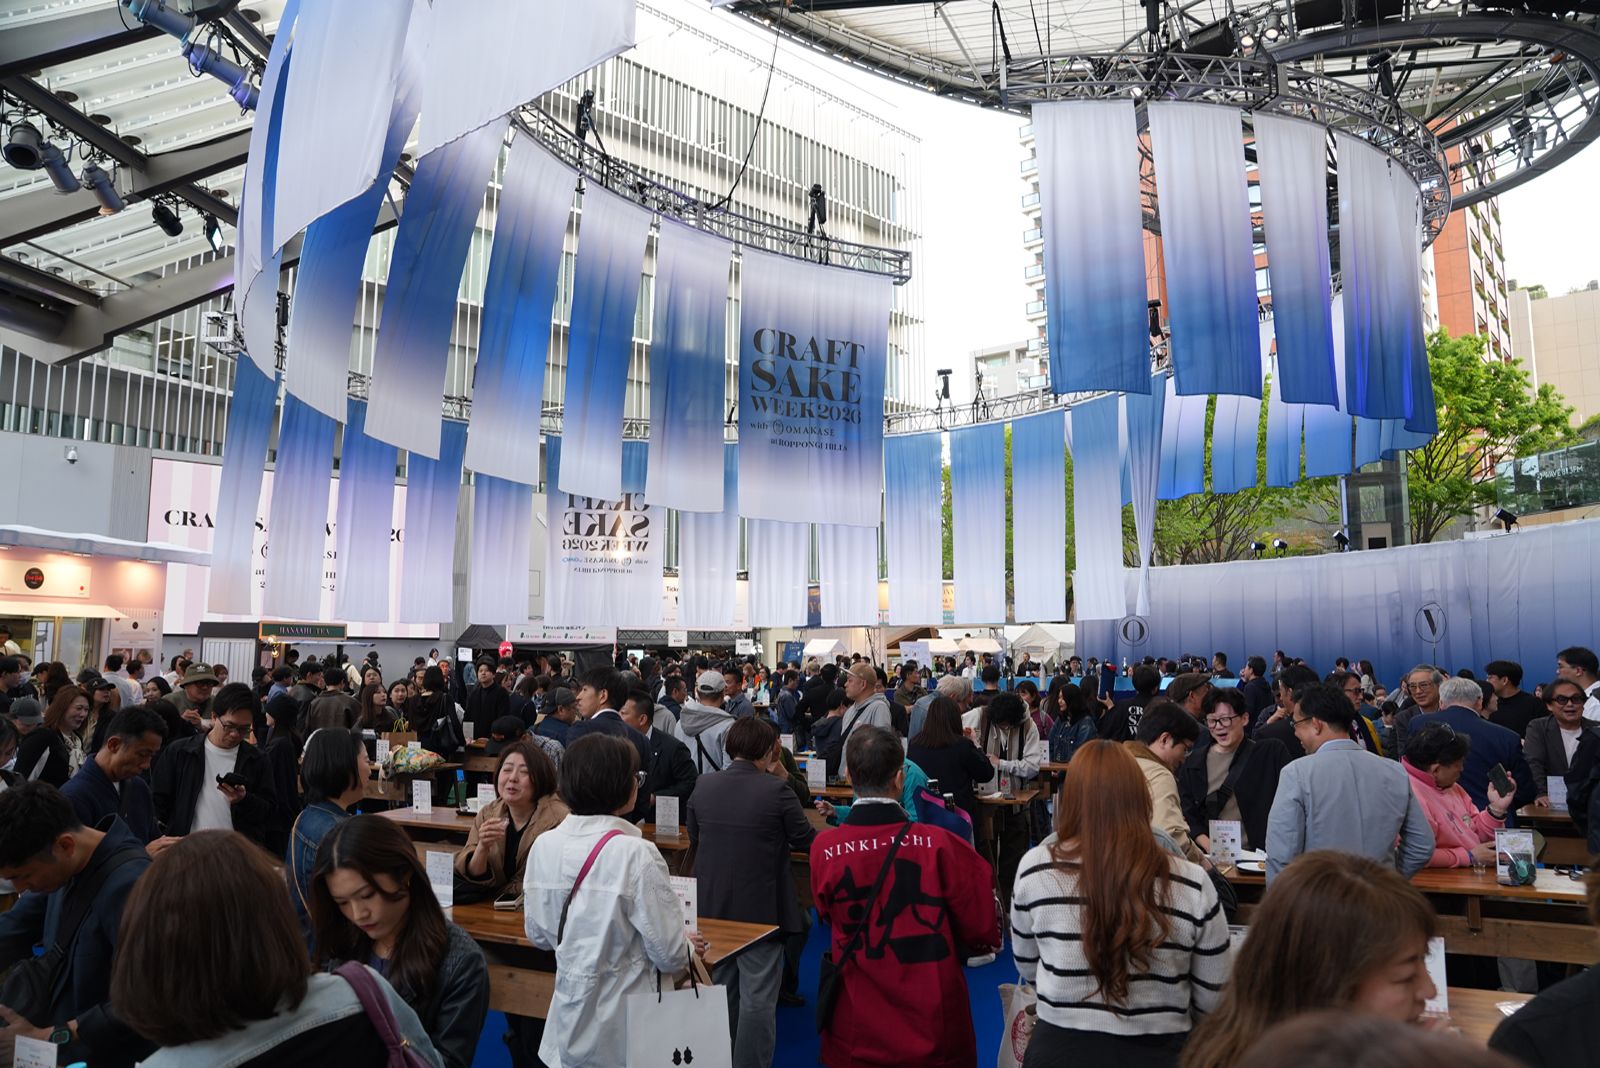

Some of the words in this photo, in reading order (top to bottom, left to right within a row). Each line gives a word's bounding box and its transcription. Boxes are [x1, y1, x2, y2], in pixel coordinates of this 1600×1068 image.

[753, 328, 865, 369] CRAFT
[751, 358, 862, 405] SAKE
[750, 422, 768, 430] with
[785, 425, 835, 437] OMAKASE
[164, 509, 215, 528] CRA
